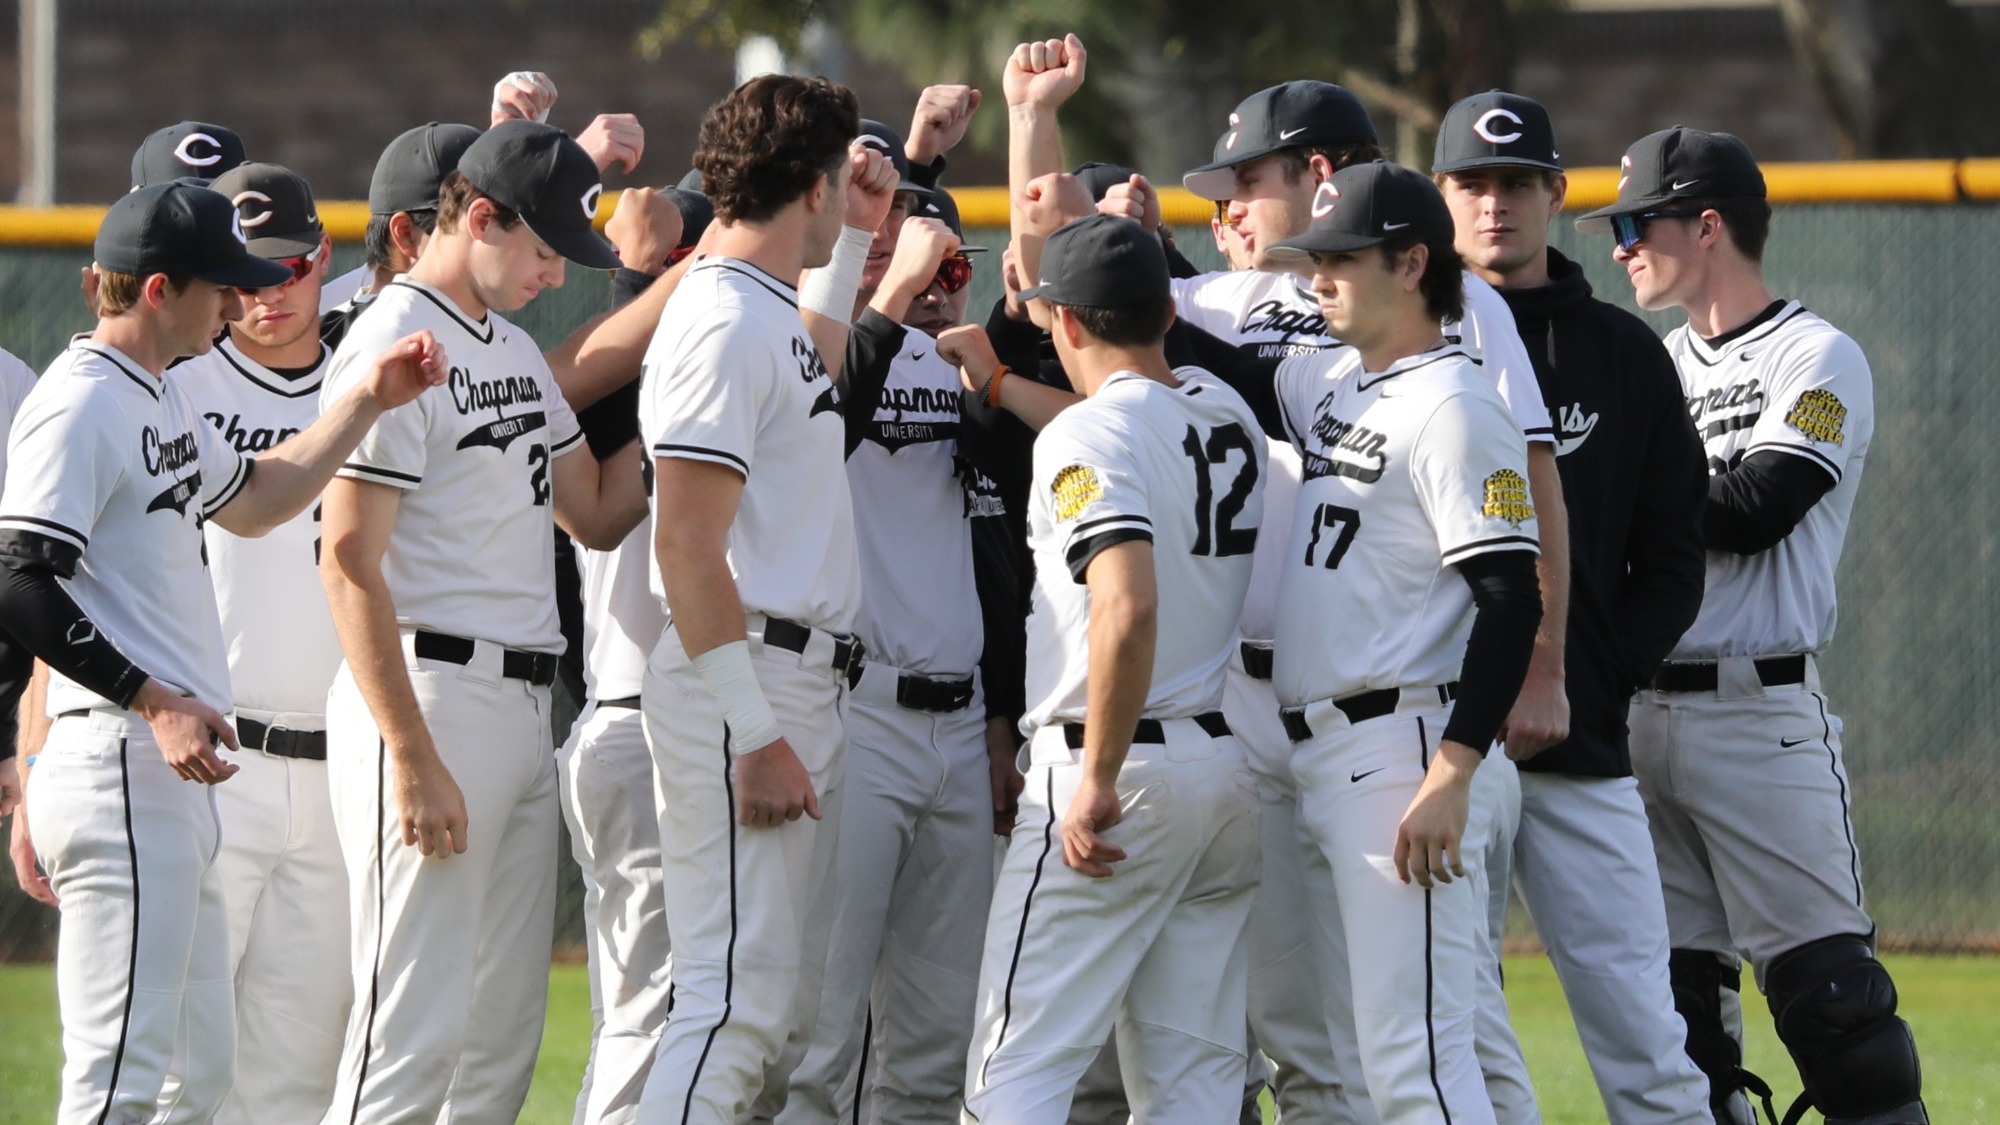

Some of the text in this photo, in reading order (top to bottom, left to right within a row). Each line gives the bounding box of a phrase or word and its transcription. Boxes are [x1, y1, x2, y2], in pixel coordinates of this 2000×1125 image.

[1473, 108, 1524, 144] C
[174, 132, 223, 166] C
[231, 190, 274, 228] C
[1311, 181, 1341, 219] C
[448, 366, 543, 421] Chapman
[1801, 392, 1846, 418] CARTER
[881, 423, 934, 440] UNVERSITY
[1787, 411, 1844, 446] FOREVER
[1796, 403, 1842, 431] STRONG
[528, 443, 550, 507] 2
[1182, 421, 1259, 557] 12
[1304, 502, 1362, 570] 17
